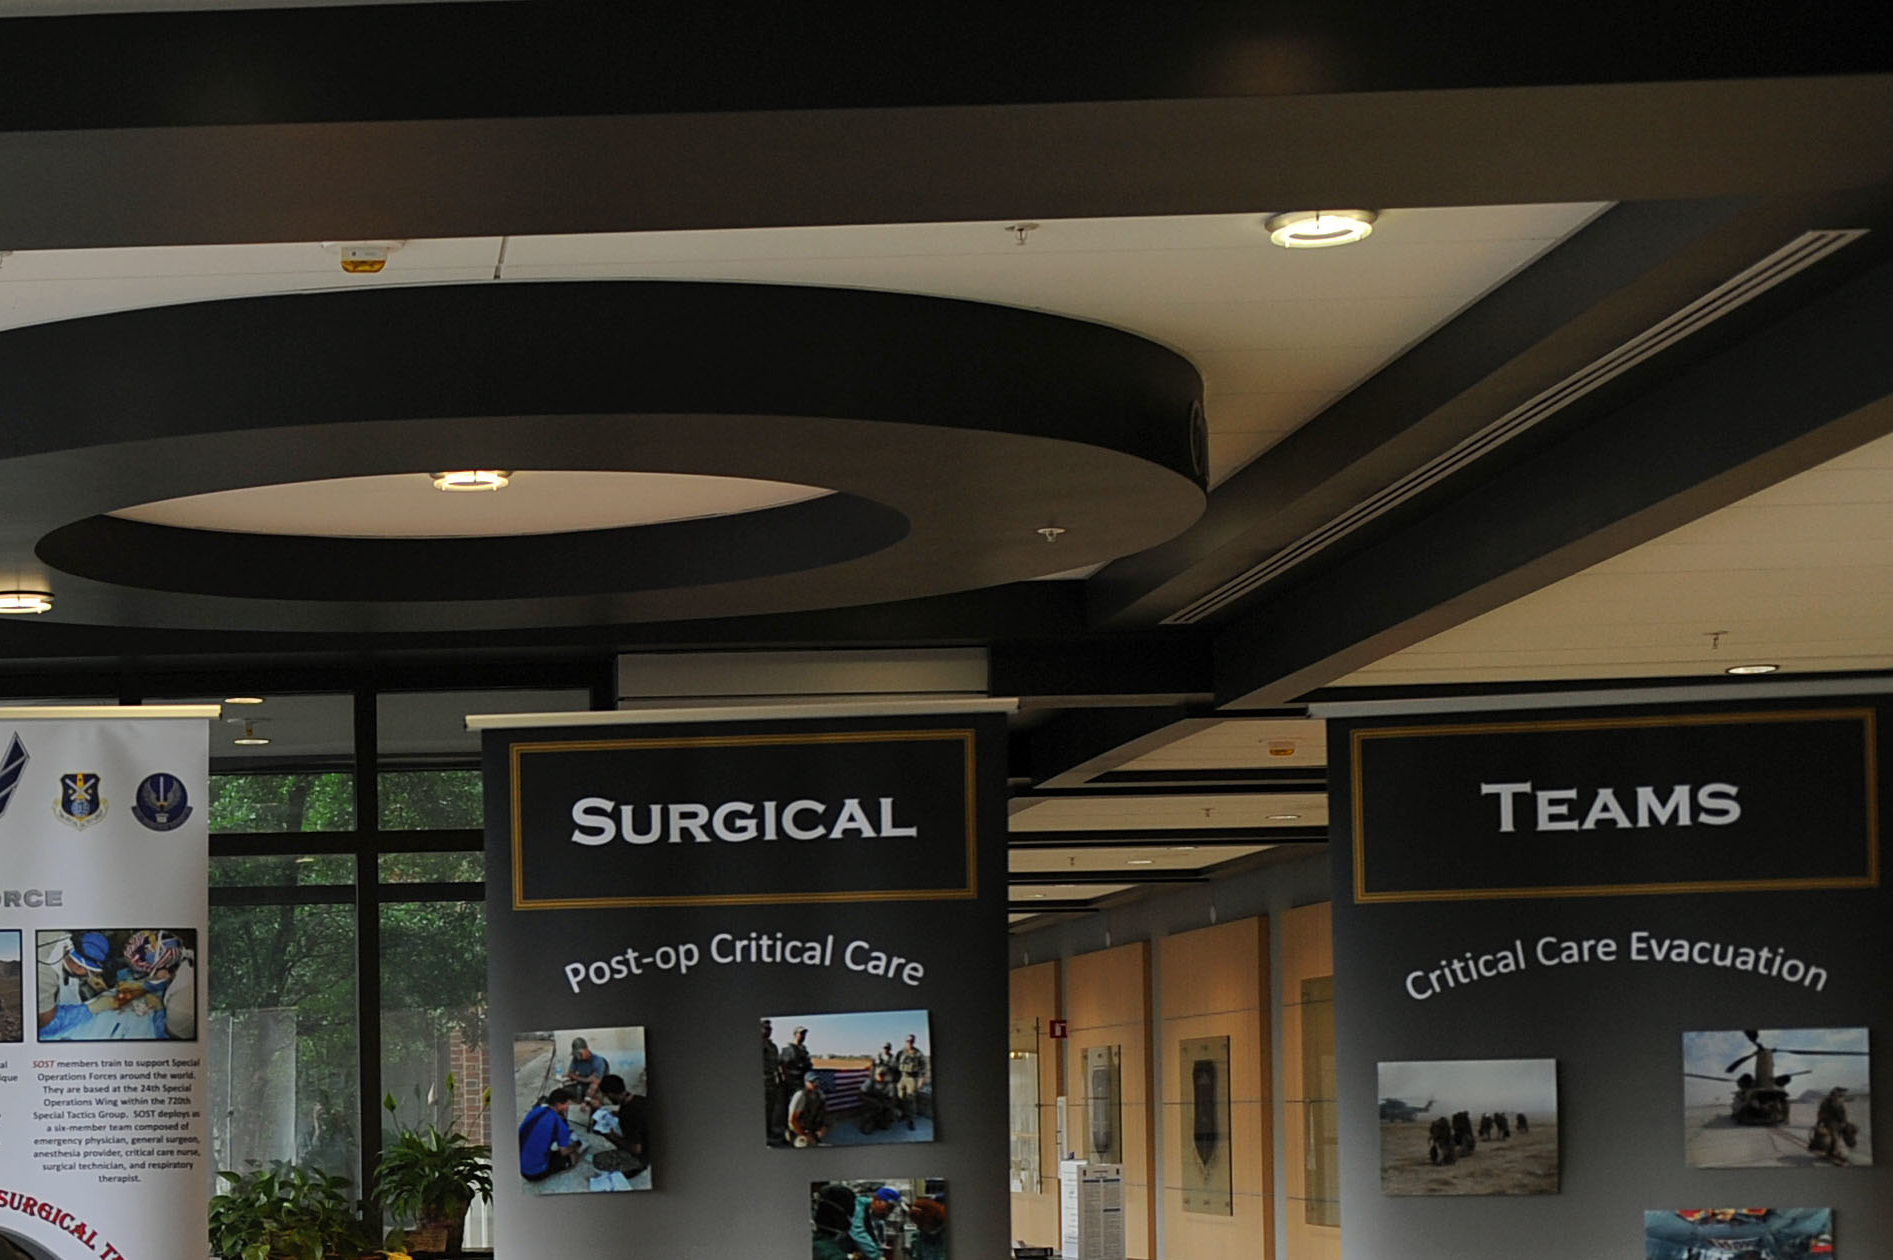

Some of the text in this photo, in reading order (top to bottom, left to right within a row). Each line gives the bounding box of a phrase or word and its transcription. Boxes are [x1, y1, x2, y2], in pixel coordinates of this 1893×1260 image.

[1481, 780, 1743, 833] TEAMS
[571, 797, 918, 846] SURGICAL
[564, 932, 926, 995] Post-op Critical Care
[1405, 931, 1830, 1001] Critical Care Evacuation
[32, 1060, 54, 1068] SOST
[57, 1060, 98, 1068] members
[101, 1060, 121, 1068] train
[136, 1060, 170, 1069] support
[172, 1059, 200, 1069] Special
[38, 1073, 86, 1082] Operations
[120, 1072, 151, 1080] around
[44, 1086, 64, 1095] They
[83, 1085, 110, 1094] based
[162, 1084, 192, 1094] Special
[34, 1112, 64, 1120] Special
[98, 1111, 128, 1120] Group.
[134, 1110, 155, 1118] SOST
[158, 1110, 190, 1120] deploys
[34, 1138, 82, 1146] emergency
[85, 1136, 128, 1146] physician,
[132, 1136, 164, 1145] general
